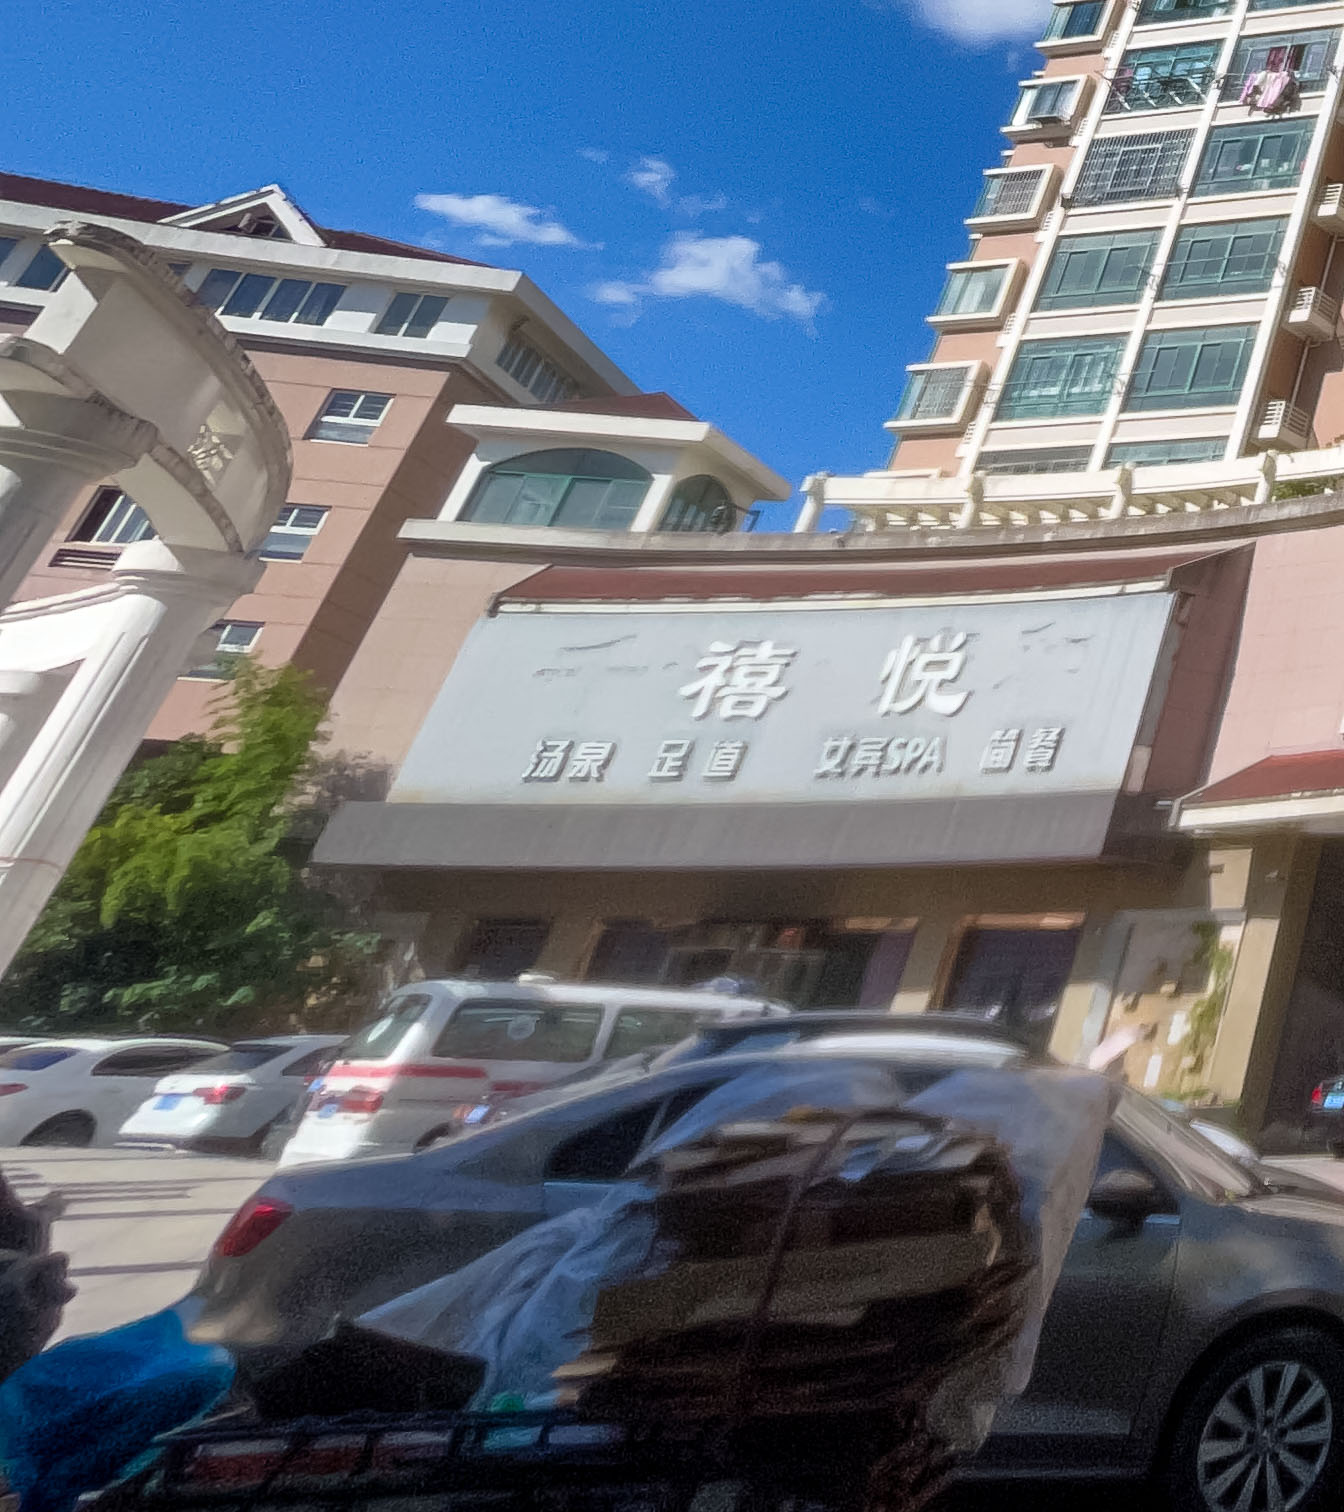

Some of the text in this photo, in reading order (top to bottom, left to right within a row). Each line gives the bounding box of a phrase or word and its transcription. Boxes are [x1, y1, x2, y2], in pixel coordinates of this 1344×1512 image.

[679, 630, 973, 722] 禧悦
[521, 737, 617, 783] 汤泉
[648, 737, 750, 782] 足道
[979, 726, 1066, 775] 简餐
